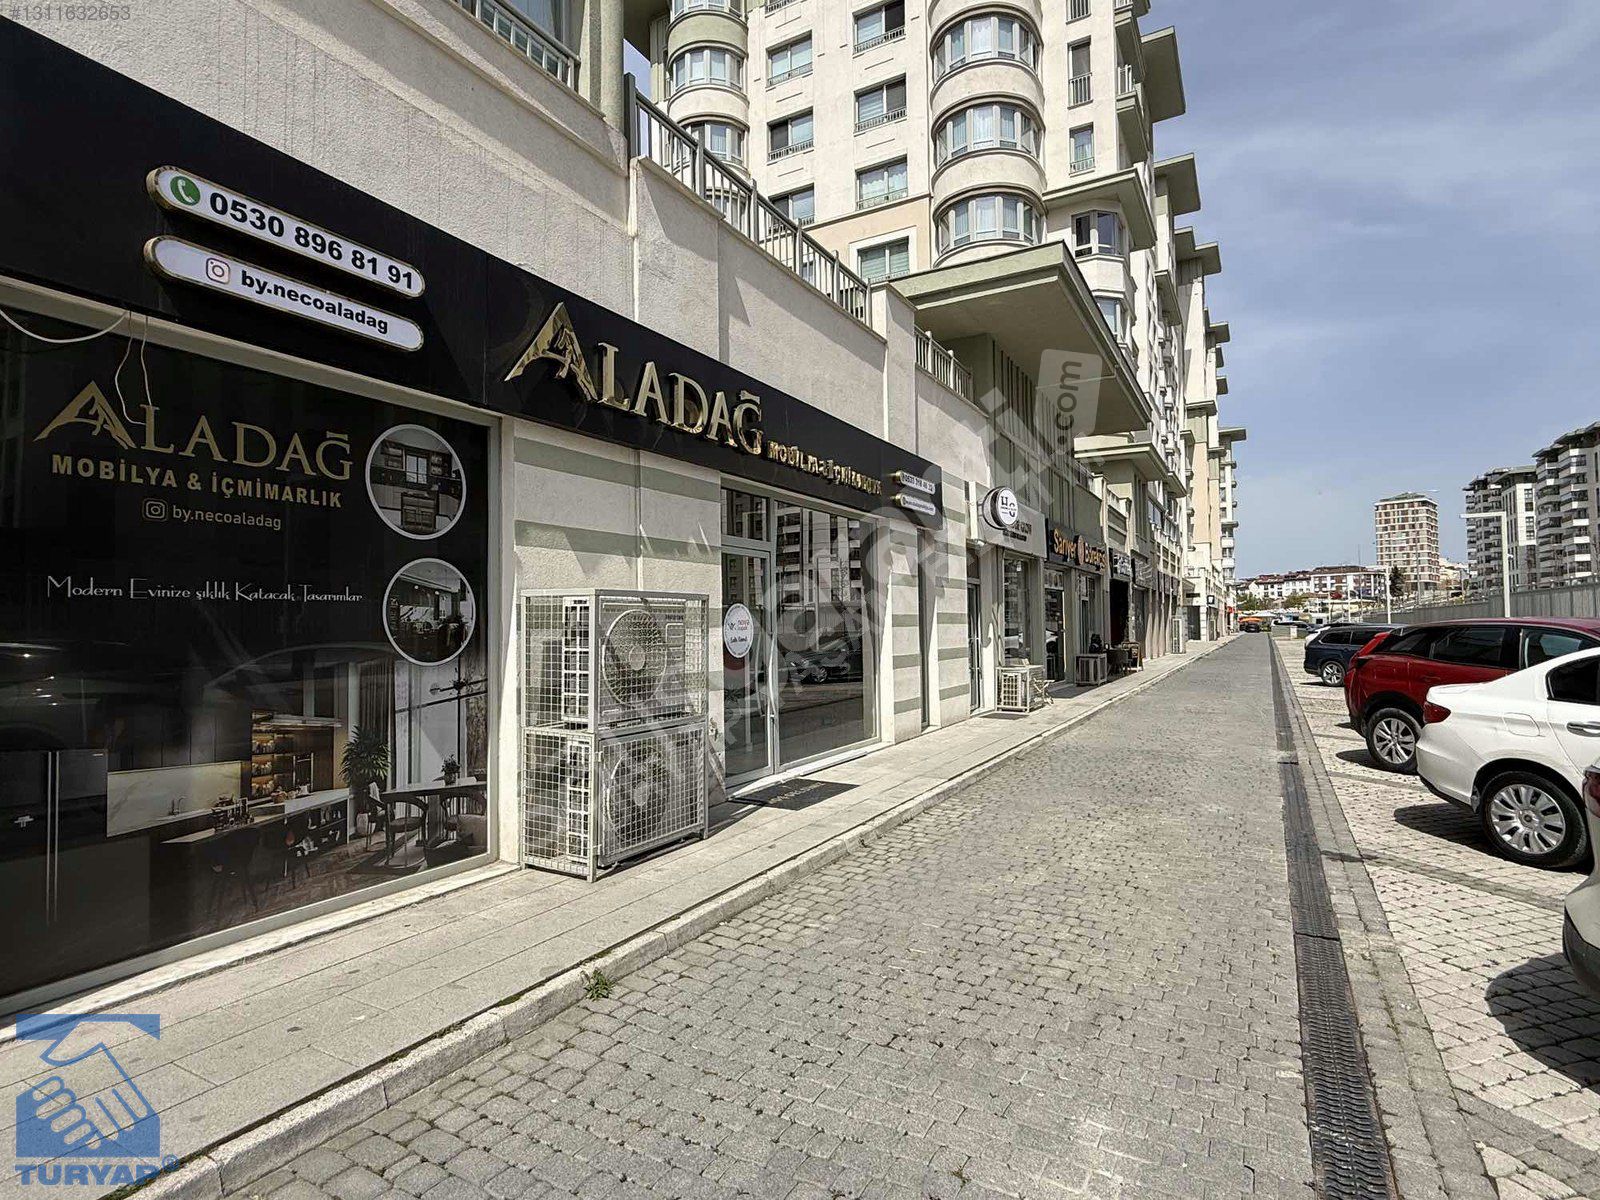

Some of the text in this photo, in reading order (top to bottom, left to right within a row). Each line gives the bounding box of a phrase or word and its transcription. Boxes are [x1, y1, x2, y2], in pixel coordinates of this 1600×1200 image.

[209, 192, 413, 290] 0530 896 81 91
[241, 270, 388, 335] by.necoaladag
[51, 453, 342, 508] MOBİLYA & İÇMİMARLIK
[172, 504, 282, 531] by.necoaladag
[47, 575, 123, 598] Modern
[130, 578, 191, 599] Evinize
[235, 581, 295, 601] Katacak
[299, 584, 364, 602] Tasarımlar
